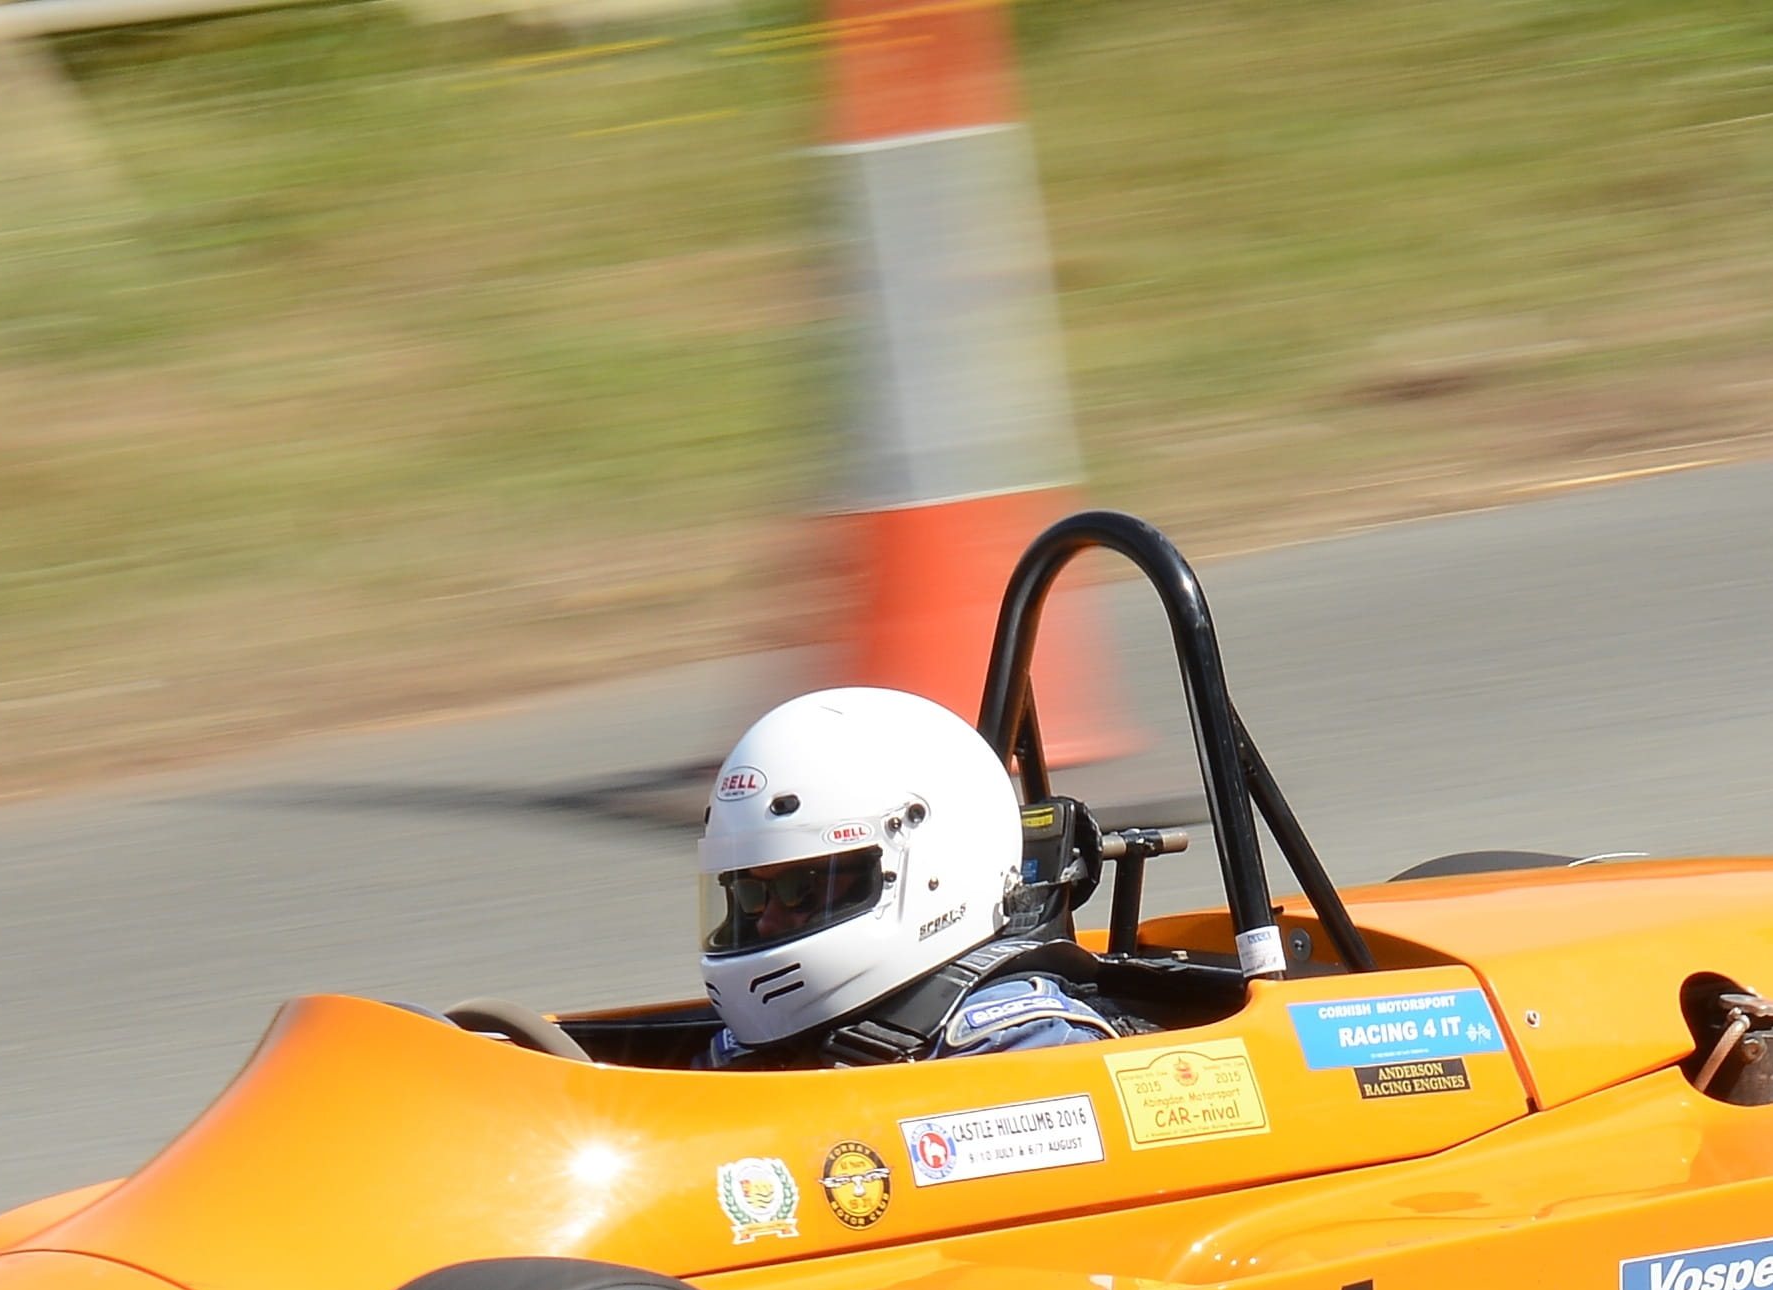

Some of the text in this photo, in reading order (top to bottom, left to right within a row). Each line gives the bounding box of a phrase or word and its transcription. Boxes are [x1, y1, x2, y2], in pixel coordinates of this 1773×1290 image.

[721, 773, 758, 791] BELL
[833, 826, 867, 839] BELL
[1318, 995, 1457, 1020] CORNISH MOTORSPORT
[1338, 1015, 1462, 1048] RACING 4 IT
[1214, 1071, 1242, 1084] 2015
[1378, 1062, 1444, 1082] ANDERSON
[1135, 1080, 1163, 1095] 2015
[1363, 1074, 1466, 1097] RACING ENGINES
[951, 1106, 1087, 1143] CASTLE HILLCLIMB 2016
[1154, 1099, 1241, 1129] CAR-nival
[1048, 1137, 1083, 1153] AUGUST
[830, 1200, 866, 1225] MOTOR
